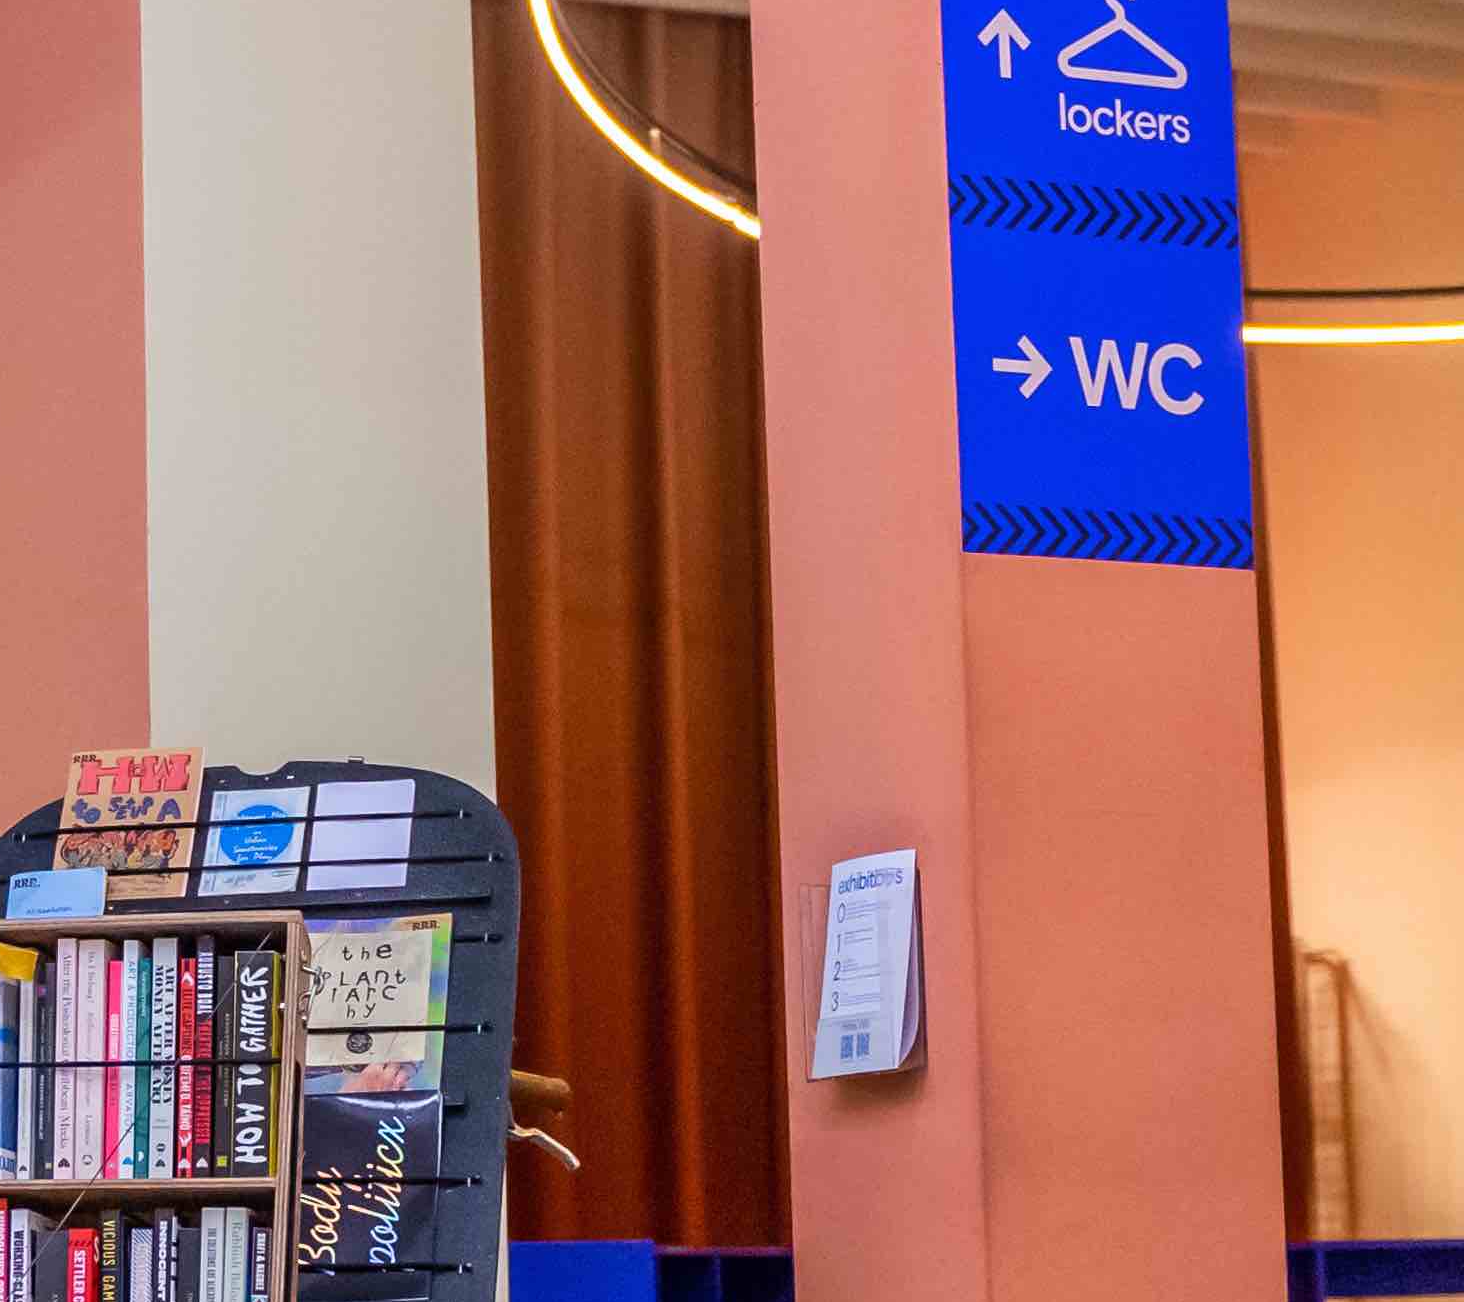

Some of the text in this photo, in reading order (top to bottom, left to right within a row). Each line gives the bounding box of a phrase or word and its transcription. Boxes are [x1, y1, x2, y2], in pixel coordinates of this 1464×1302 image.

[1058, 92, 1190, 144] lockers
[1068, 334, 1203, 417] WC
[157, 798, 181, 821] A
[153, 966, 163, 1016] MONEY
[164, 966, 174, 992] ART
[198, 952, 213, 1015] AUGUSTO BOAL
[163, 1001, 174, 1049] AFTER
[235, 967, 269, 1163] HOW TO GATHER
[103, 1219, 115, 1266] VICIOUS
[156, 1220, 168, 1301] INNOCENT
[73, 1249, 86, 1295] SETTLER
